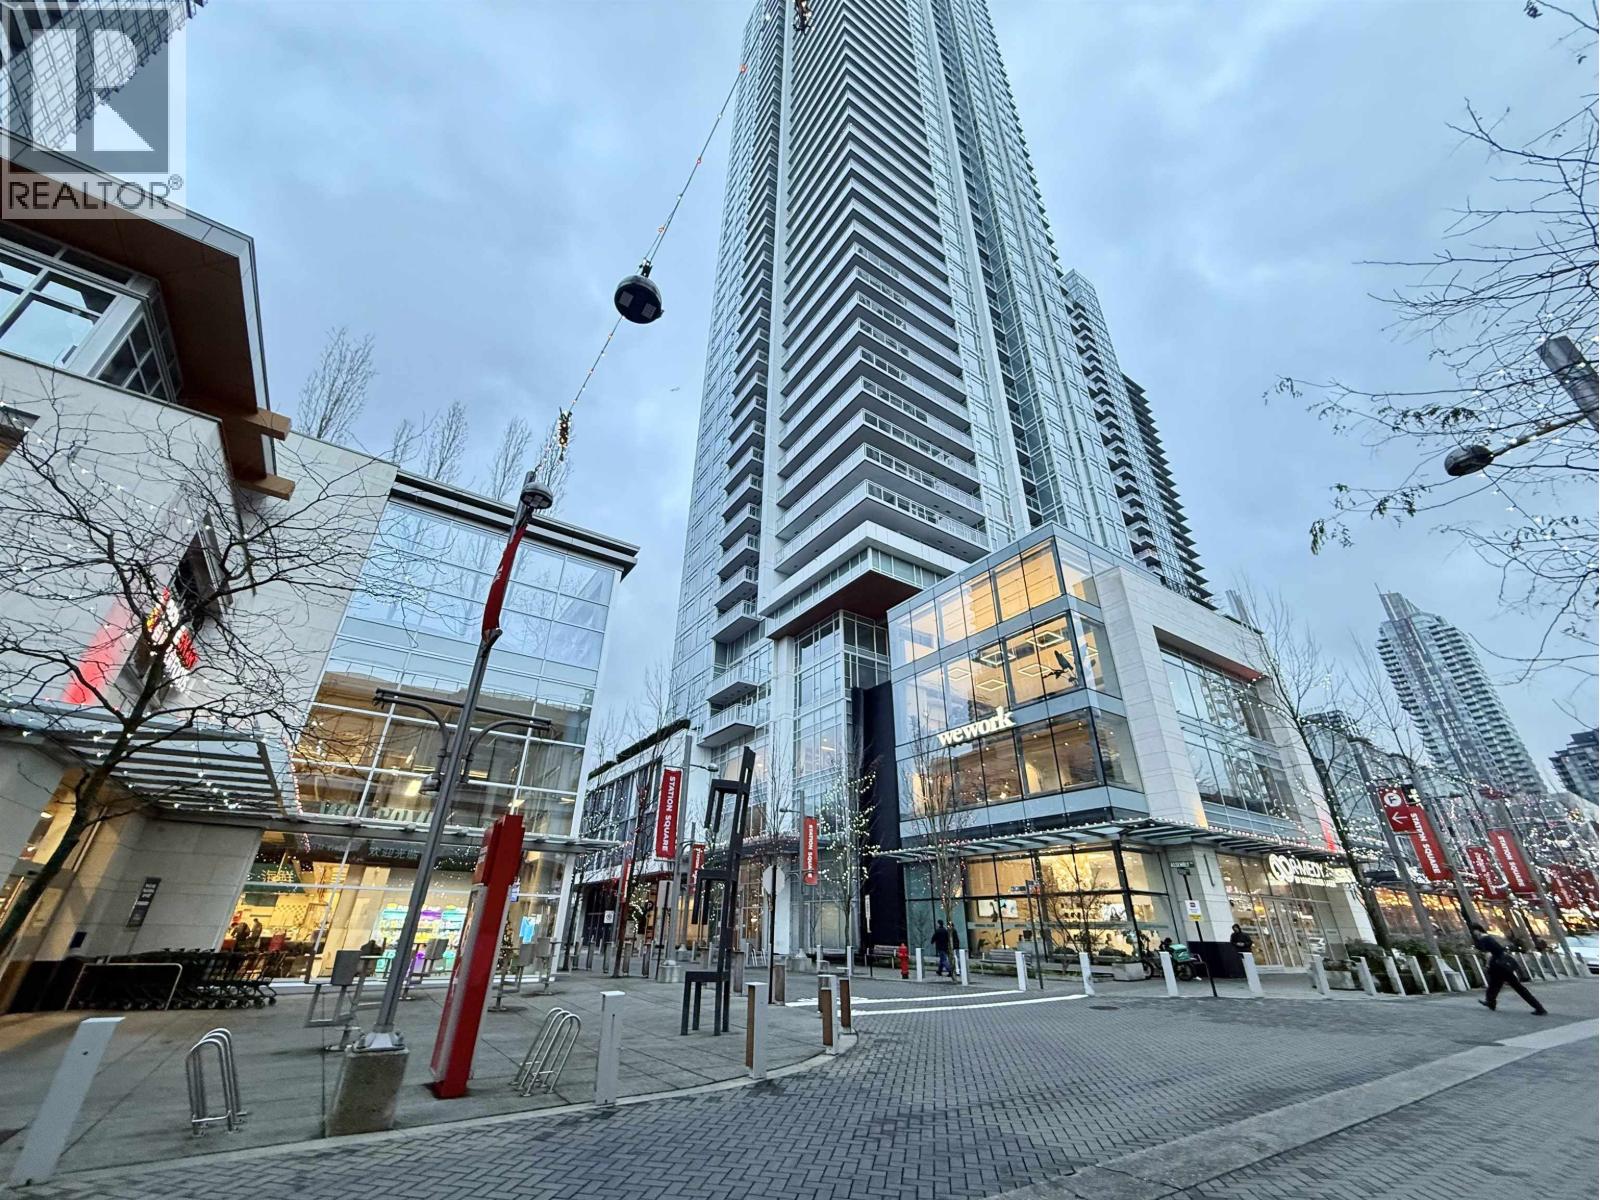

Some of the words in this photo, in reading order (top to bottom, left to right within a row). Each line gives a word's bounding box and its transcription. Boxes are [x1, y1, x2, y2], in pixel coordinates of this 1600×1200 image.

[937, 705, 1016, 746] wework
[666, 776, 676, 811] STATION
[662, 815, 672, 852] SQUARE
[1422, 843, 1441, 874] SQUARE
[1498, 835, 1513, 861] STATION
[1508, 861, 1525, 888] SQUARE
